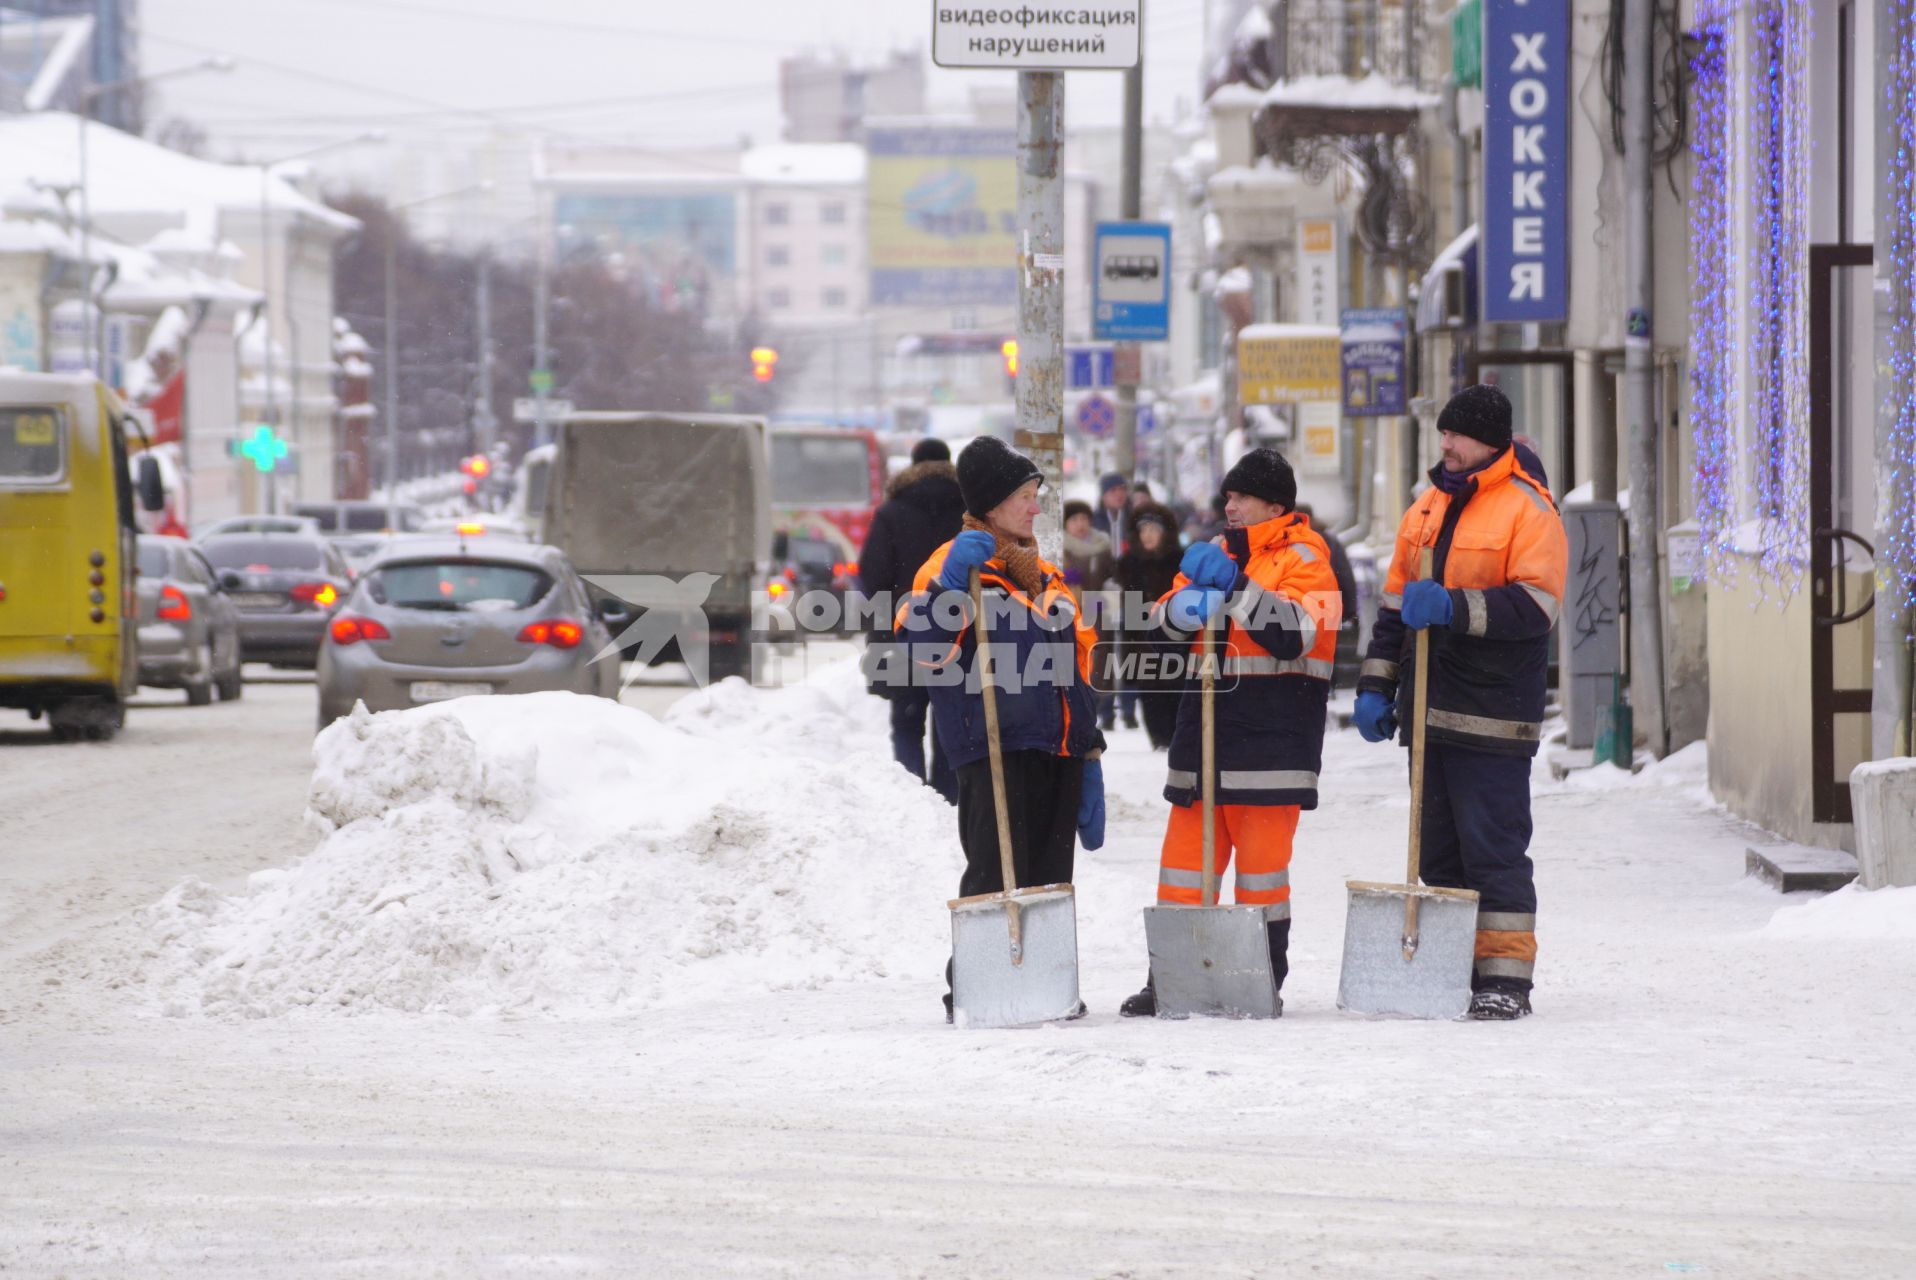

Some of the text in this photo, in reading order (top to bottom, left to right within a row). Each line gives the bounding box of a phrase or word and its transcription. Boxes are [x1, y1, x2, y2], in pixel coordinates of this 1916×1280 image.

[939, 7, 1135, 28] видеофиксация
[968, 35, 1105, 56] нарушений
[1508, 33, 1548, 300] ХОККЕЯ
